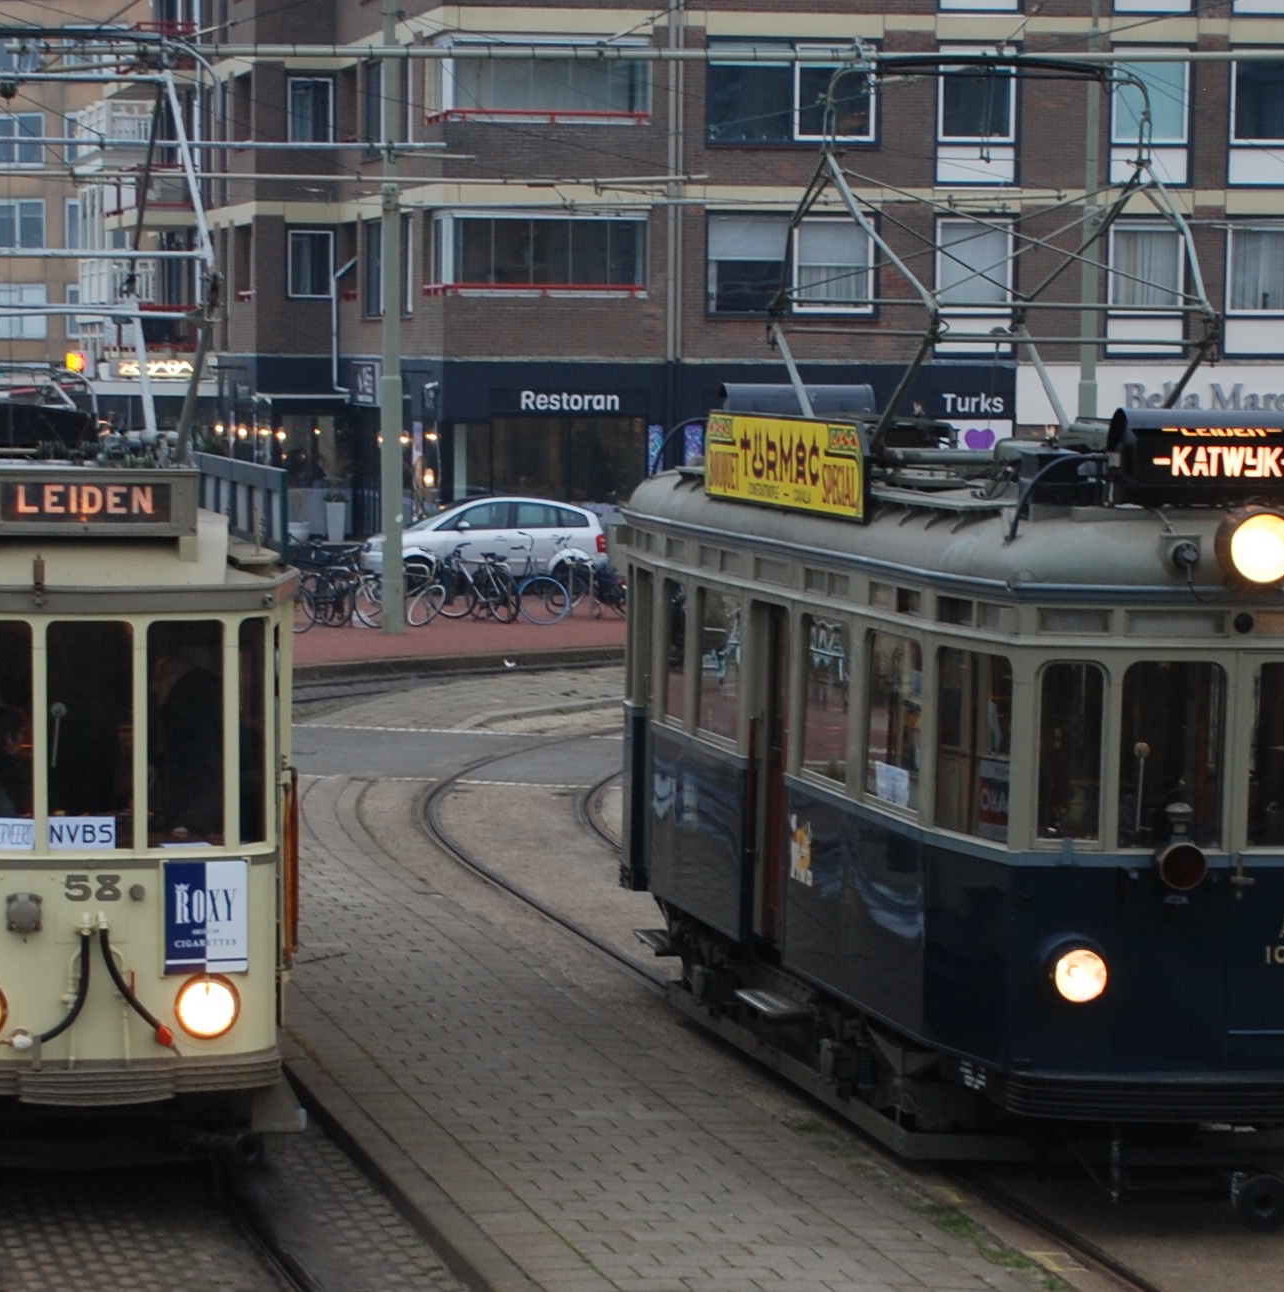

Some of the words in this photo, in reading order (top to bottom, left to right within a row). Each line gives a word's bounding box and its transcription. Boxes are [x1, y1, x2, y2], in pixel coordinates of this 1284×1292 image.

[520, 391, 619, 411] Restoran
[942, 392, 1004, 413] Turks
[740, 424, 820, 487] TURMAC
[17, 485, 154, 514] LEIDEN
[50, 823, 113, 843] NVBS
[65, 874, 122, 902] 58
[175, 888, 237, 924] ROXY
[174, 939, 237, 949] CIGARETTES
